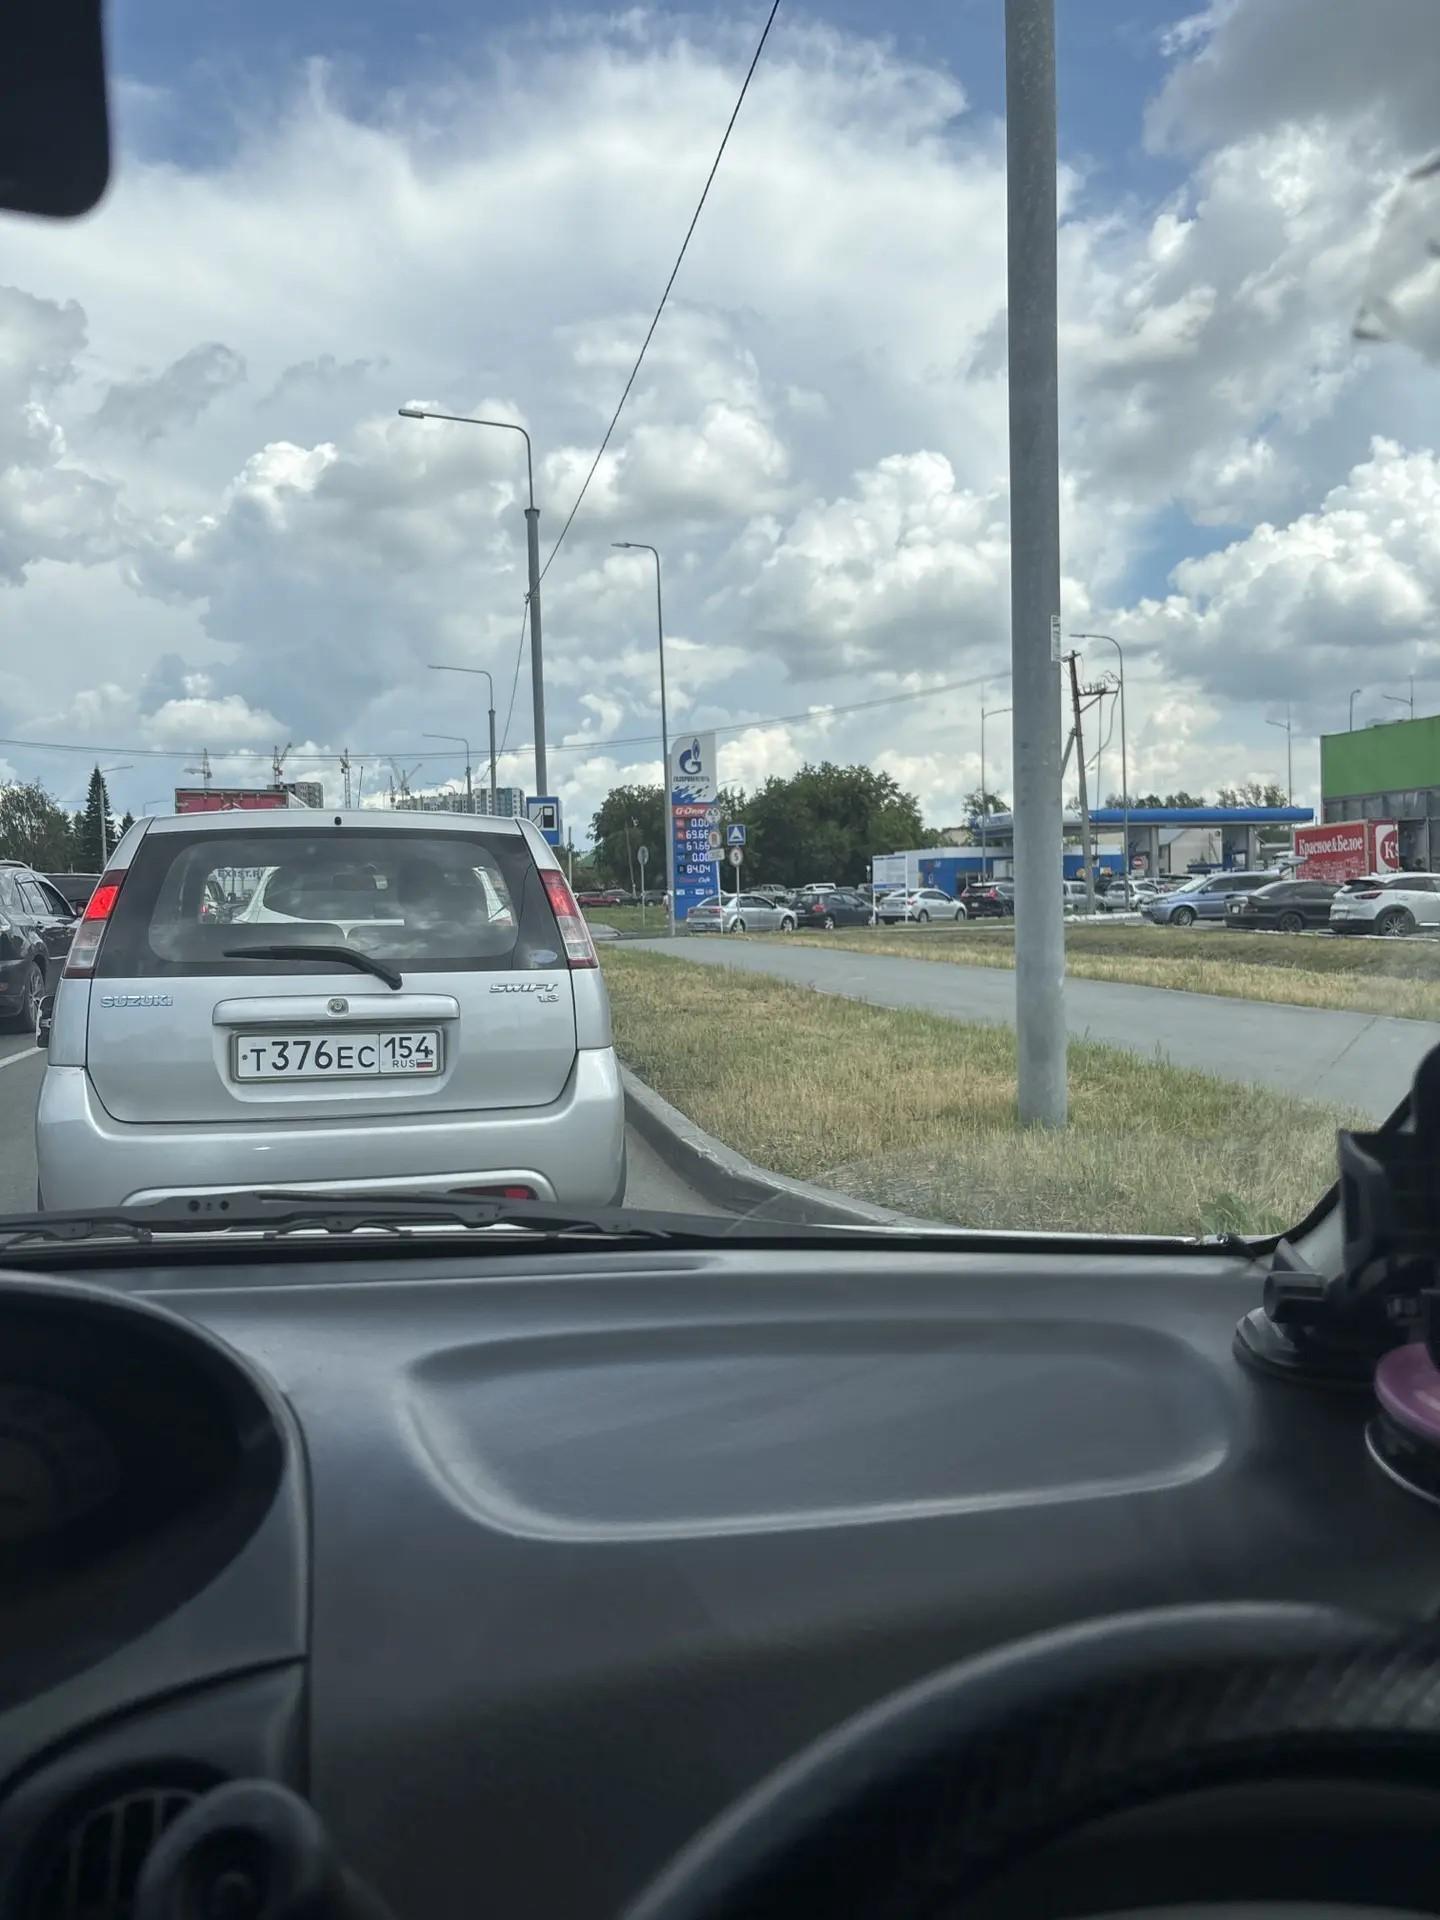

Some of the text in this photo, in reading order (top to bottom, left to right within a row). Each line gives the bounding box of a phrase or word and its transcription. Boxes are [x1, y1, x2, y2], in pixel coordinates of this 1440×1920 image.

[489, 983, 559, 993] SWIFT
[100, 994, 173, 1008] SUZUKI
[384, 1036, 431, 1060] 154
[392, 1059, 416, 1068] RUS
